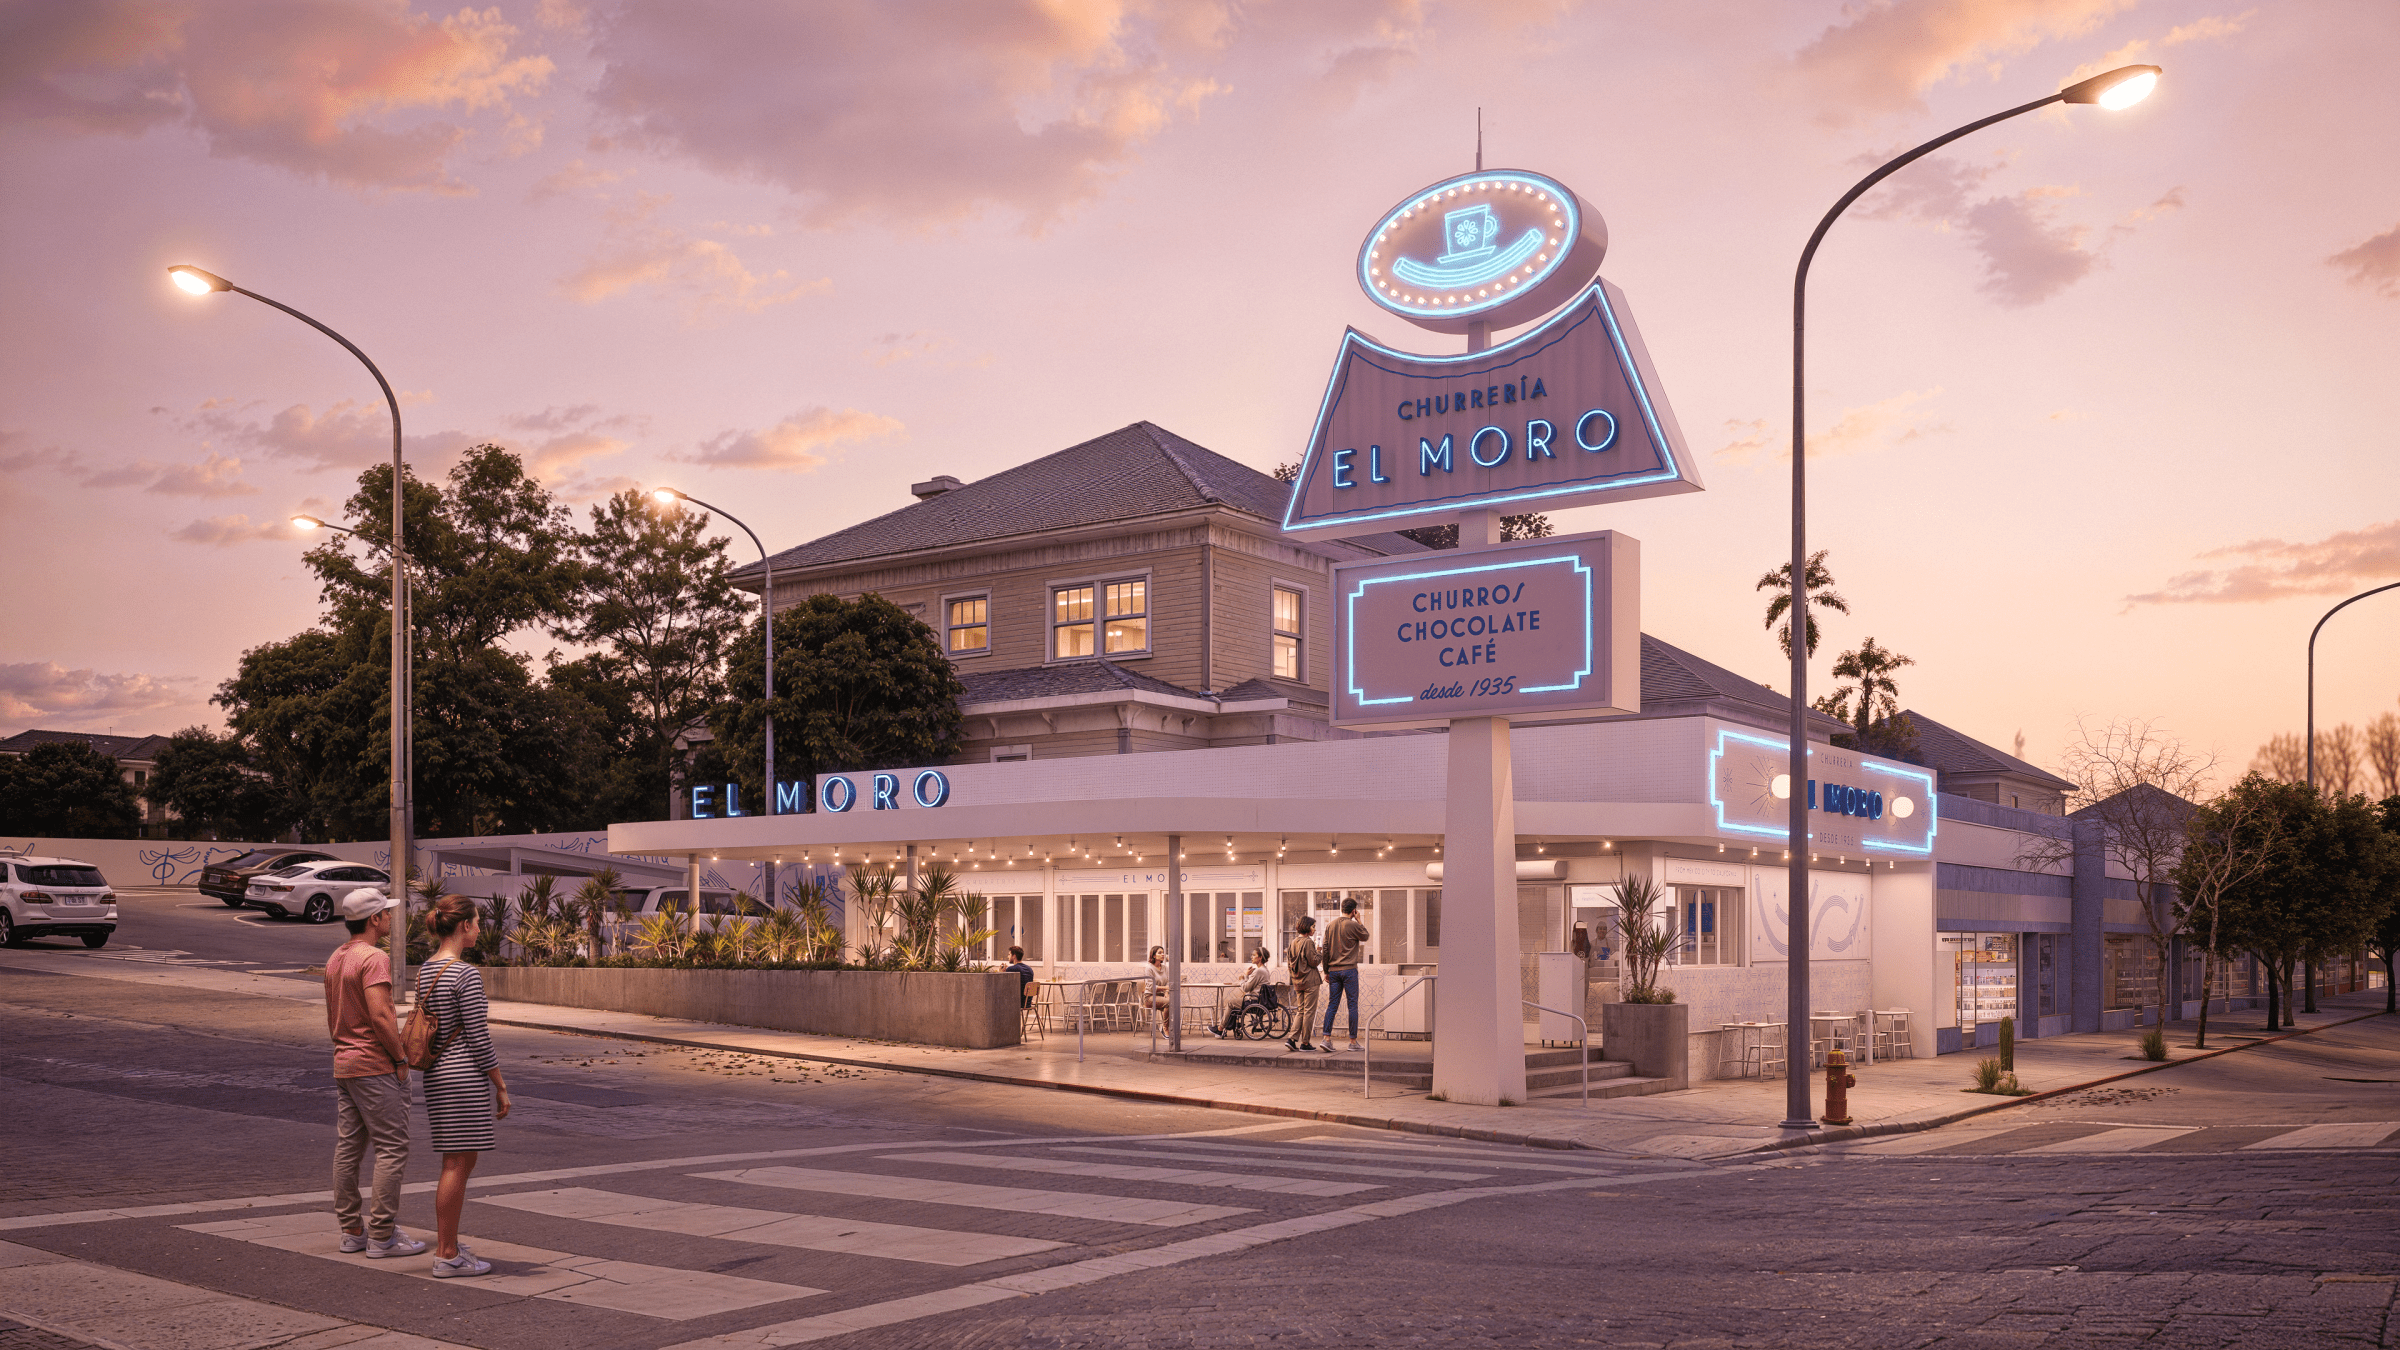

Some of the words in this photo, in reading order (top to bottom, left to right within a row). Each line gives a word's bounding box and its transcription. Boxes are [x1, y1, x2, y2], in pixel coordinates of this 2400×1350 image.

[1398, 375, 1548, 420] CHURRERÍA
[1333, 445, 1390, 489] EL
[1420, 408, 1620, 477] MORO
[1412, 582, 1525, 613] CHURROS
[1397, 610, 1540, 643] CHOCOLATE
[1439, 638, 1496, 667] CAFÉ
[1420, 682, 1465, 701] desde
[1469, 676, 1517, 698] 1935
[692, 783, 750, 819] EL
[776, 769, 951, 814] MORO
[1123, 874, 1136, 883] EL
[1145, 872, 1188, 883] MOO
